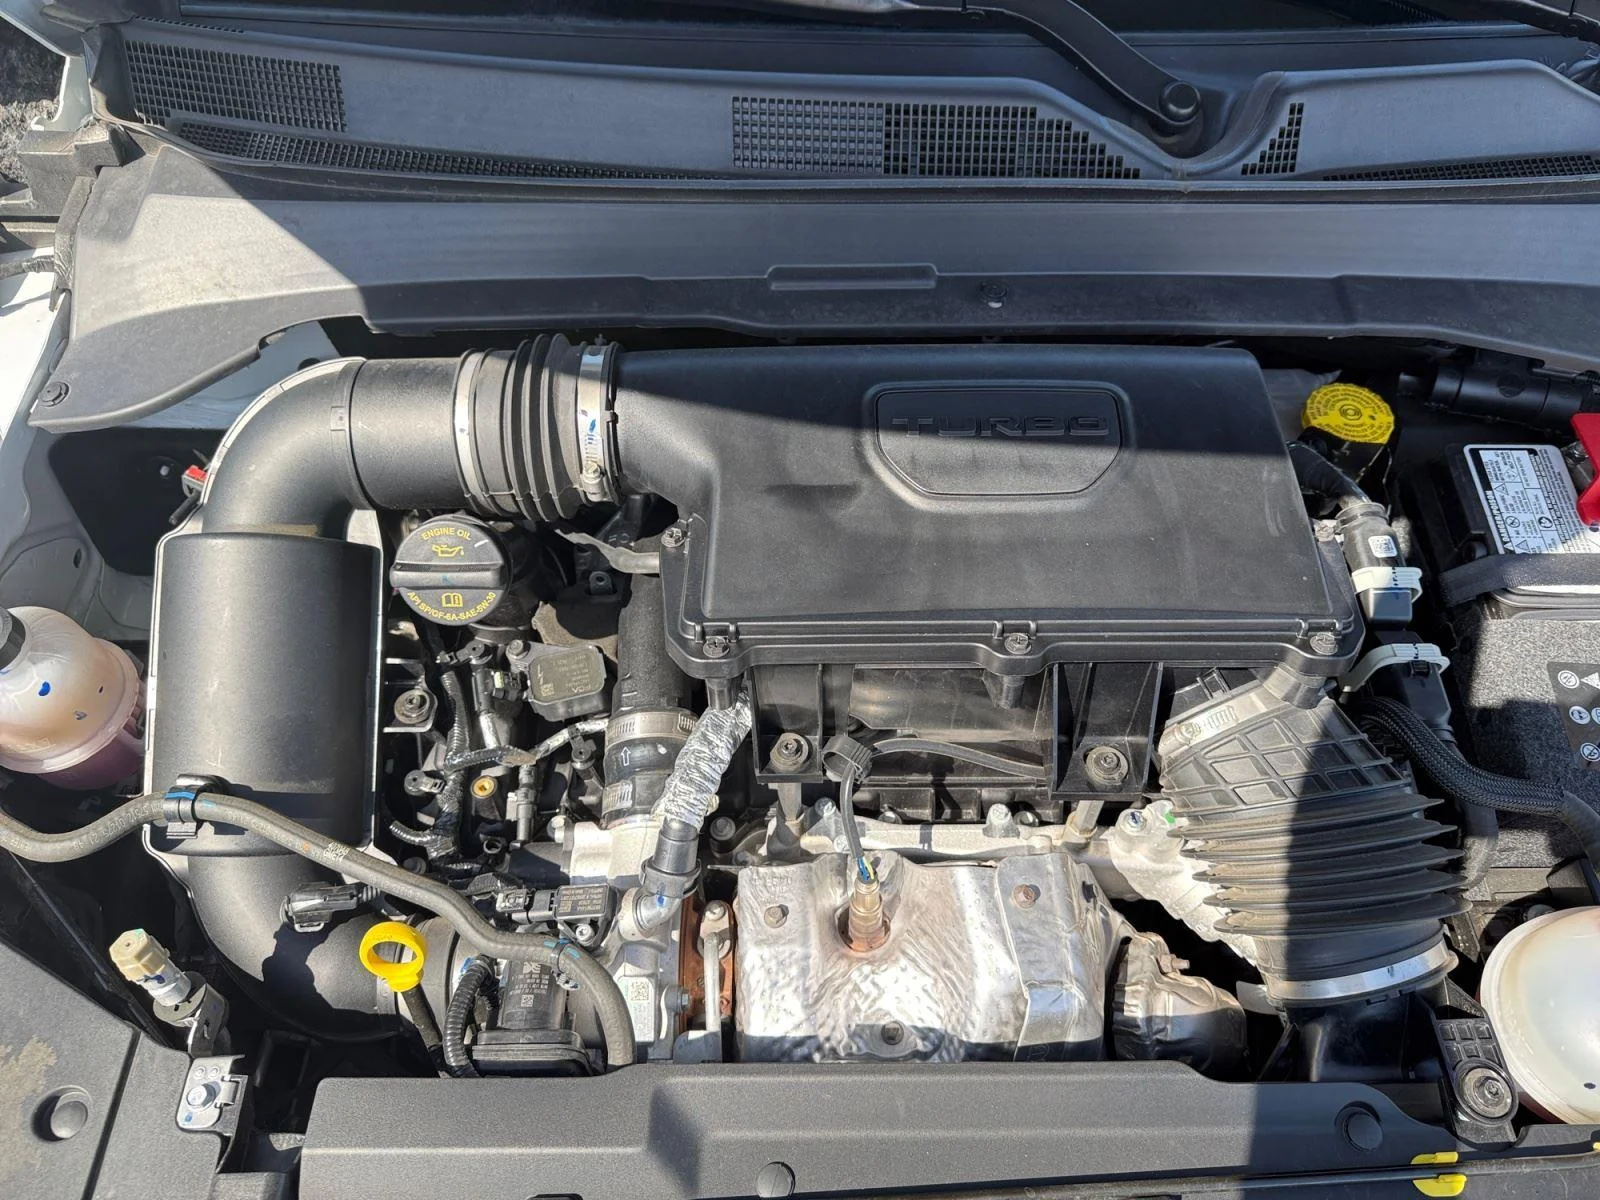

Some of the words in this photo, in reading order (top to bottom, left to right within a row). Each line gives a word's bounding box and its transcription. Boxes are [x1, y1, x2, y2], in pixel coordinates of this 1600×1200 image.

[892, 416, 1109, 438] TURBO
[421, 527, 455, 541] ENGINE
[456, 529, 472, 541] OIL
[407, 591, 421, 606] API
